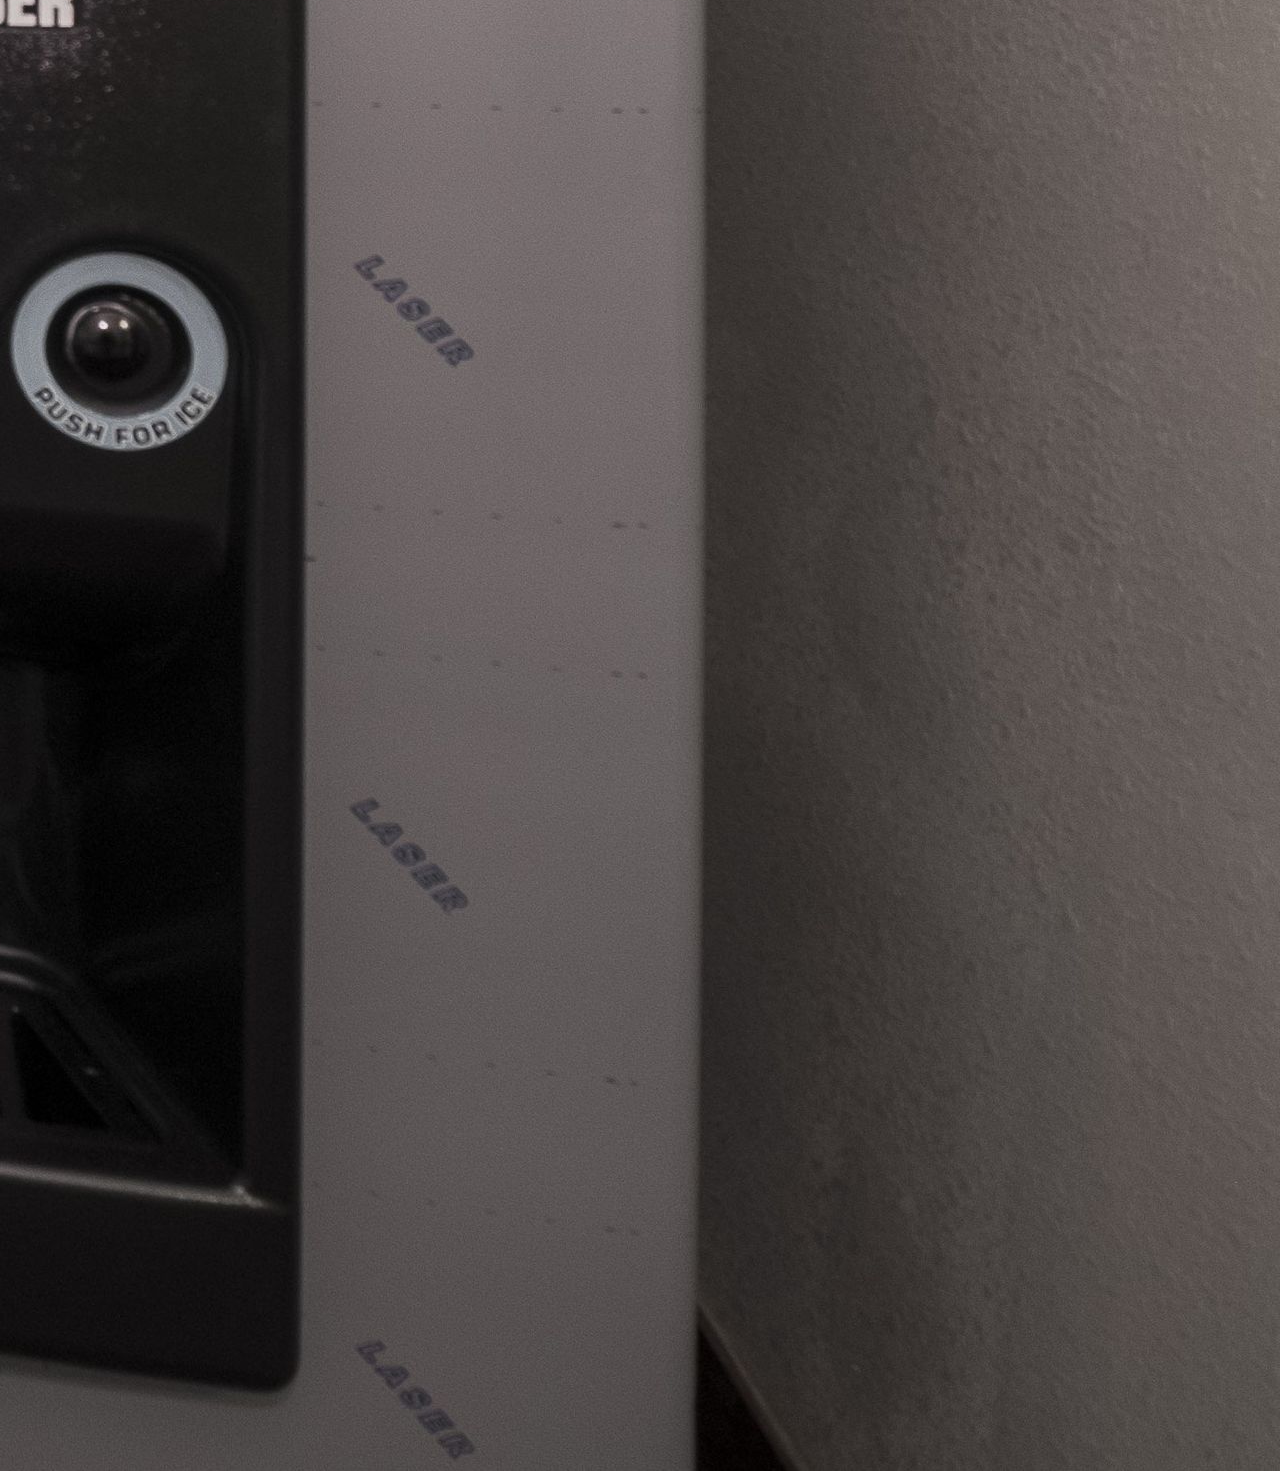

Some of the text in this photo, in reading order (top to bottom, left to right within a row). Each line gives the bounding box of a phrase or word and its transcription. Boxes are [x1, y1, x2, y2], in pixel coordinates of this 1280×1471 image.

[354, 254, 475, 367] LASER
[34, 386, 214, 446] PUSH FOR ICE
[350, 797, 468, 913] LASER
[354, 1339, 475, 1460] LASER
